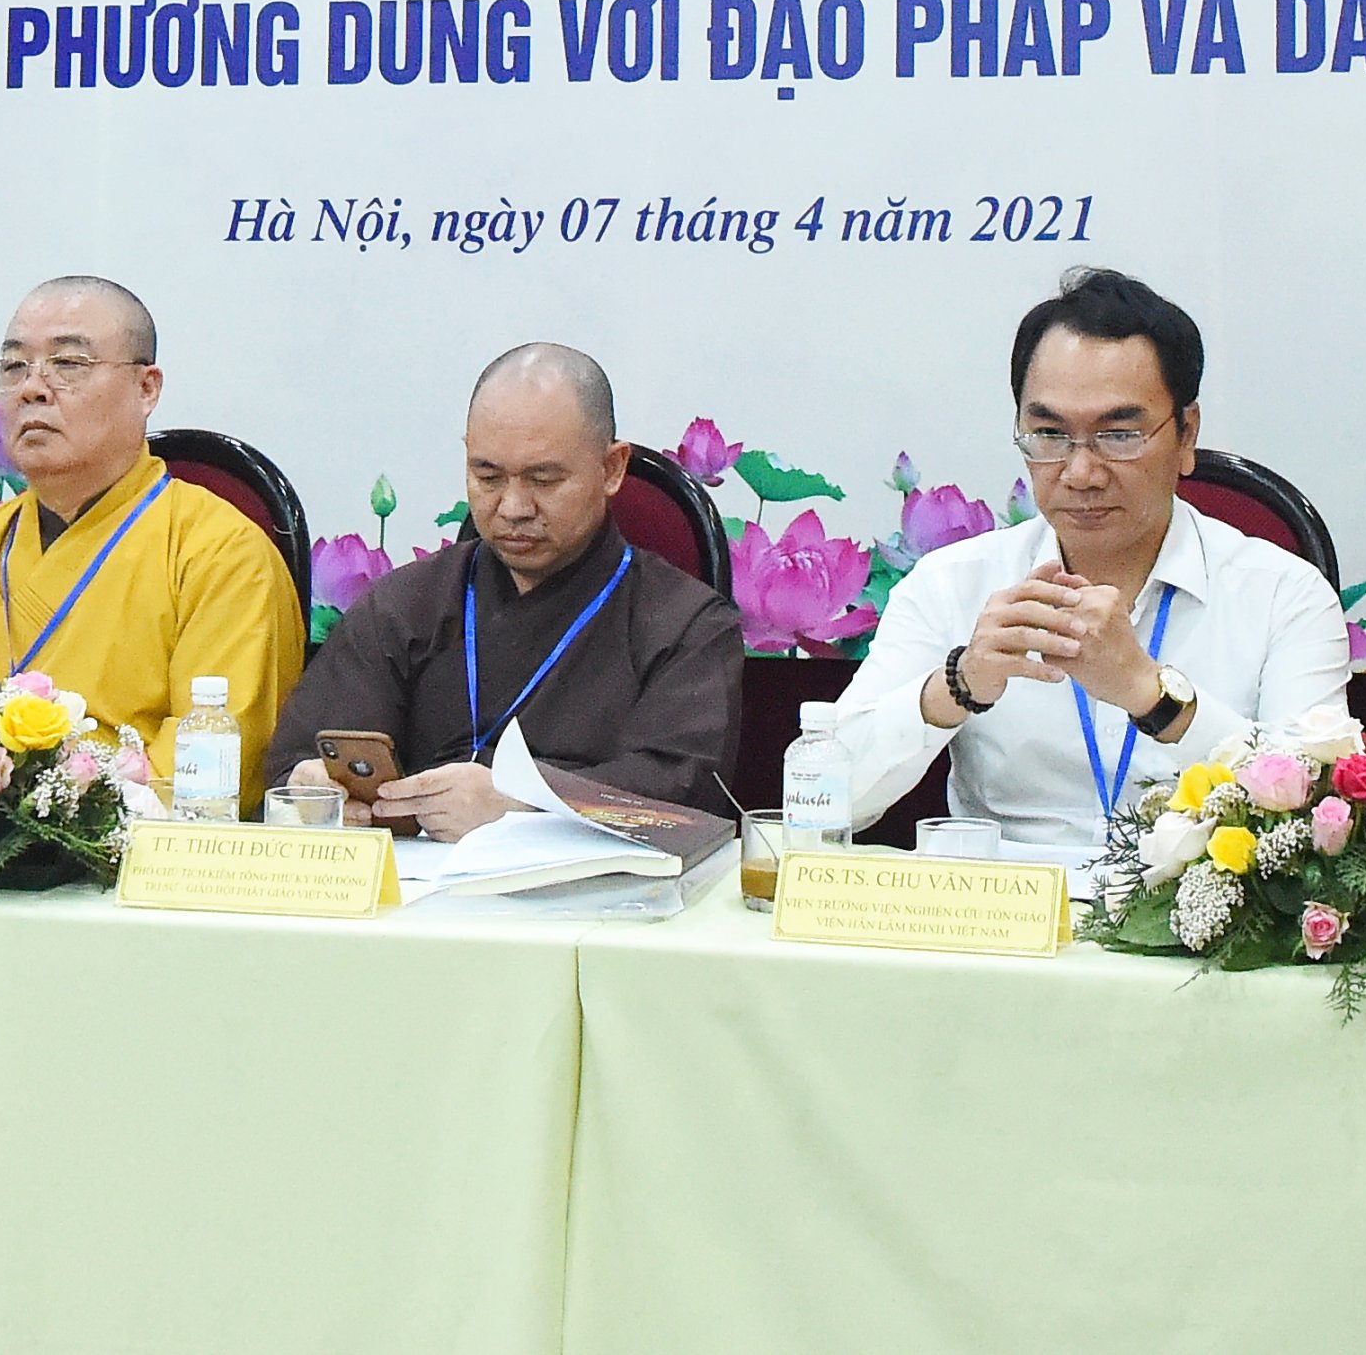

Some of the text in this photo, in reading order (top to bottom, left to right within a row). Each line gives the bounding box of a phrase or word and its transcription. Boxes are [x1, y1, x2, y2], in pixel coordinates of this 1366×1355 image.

[225, 195, 1094, 255] Hà Nội, ngày 07 tháng 4 năm 2021
[153, 835, 358, 864] TT. THÍCH ĐỨC THIỆN
[797, 865, 869, 886] PGS.TS.
[876, 870, 921, 889] CHU
[928, 871, 973, 892] VĂN
[979, 926, 1010, 939] NAM
